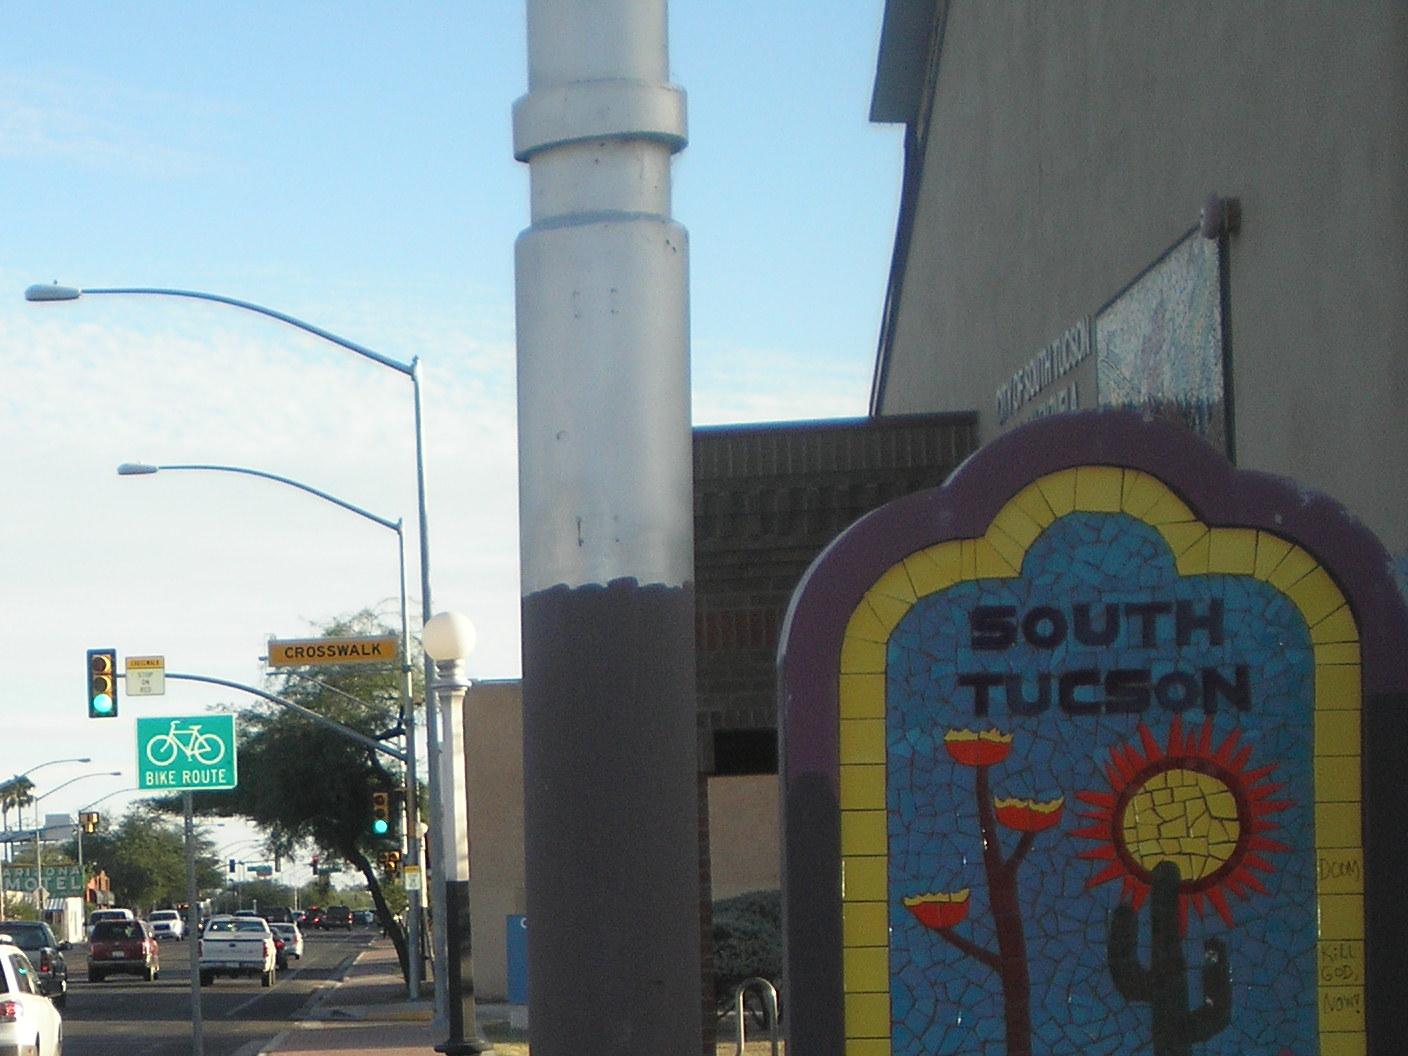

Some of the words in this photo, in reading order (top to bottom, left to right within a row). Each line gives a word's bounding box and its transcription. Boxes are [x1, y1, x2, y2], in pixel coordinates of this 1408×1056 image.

[1052, 313, 1092, 378] TUCSON
[968, 598, 1225, 650] SOUTH
[284, 643, 382, 659] CROSSWALK
[957, 663, 1252, 717] TUCSON
[145, 771, 177, 785] BIKE
[182, 769, 227, 784] ROUTE
[3, 866, 81, 878] ARIZONA
[5, 877, 81, 892] MOTEL
